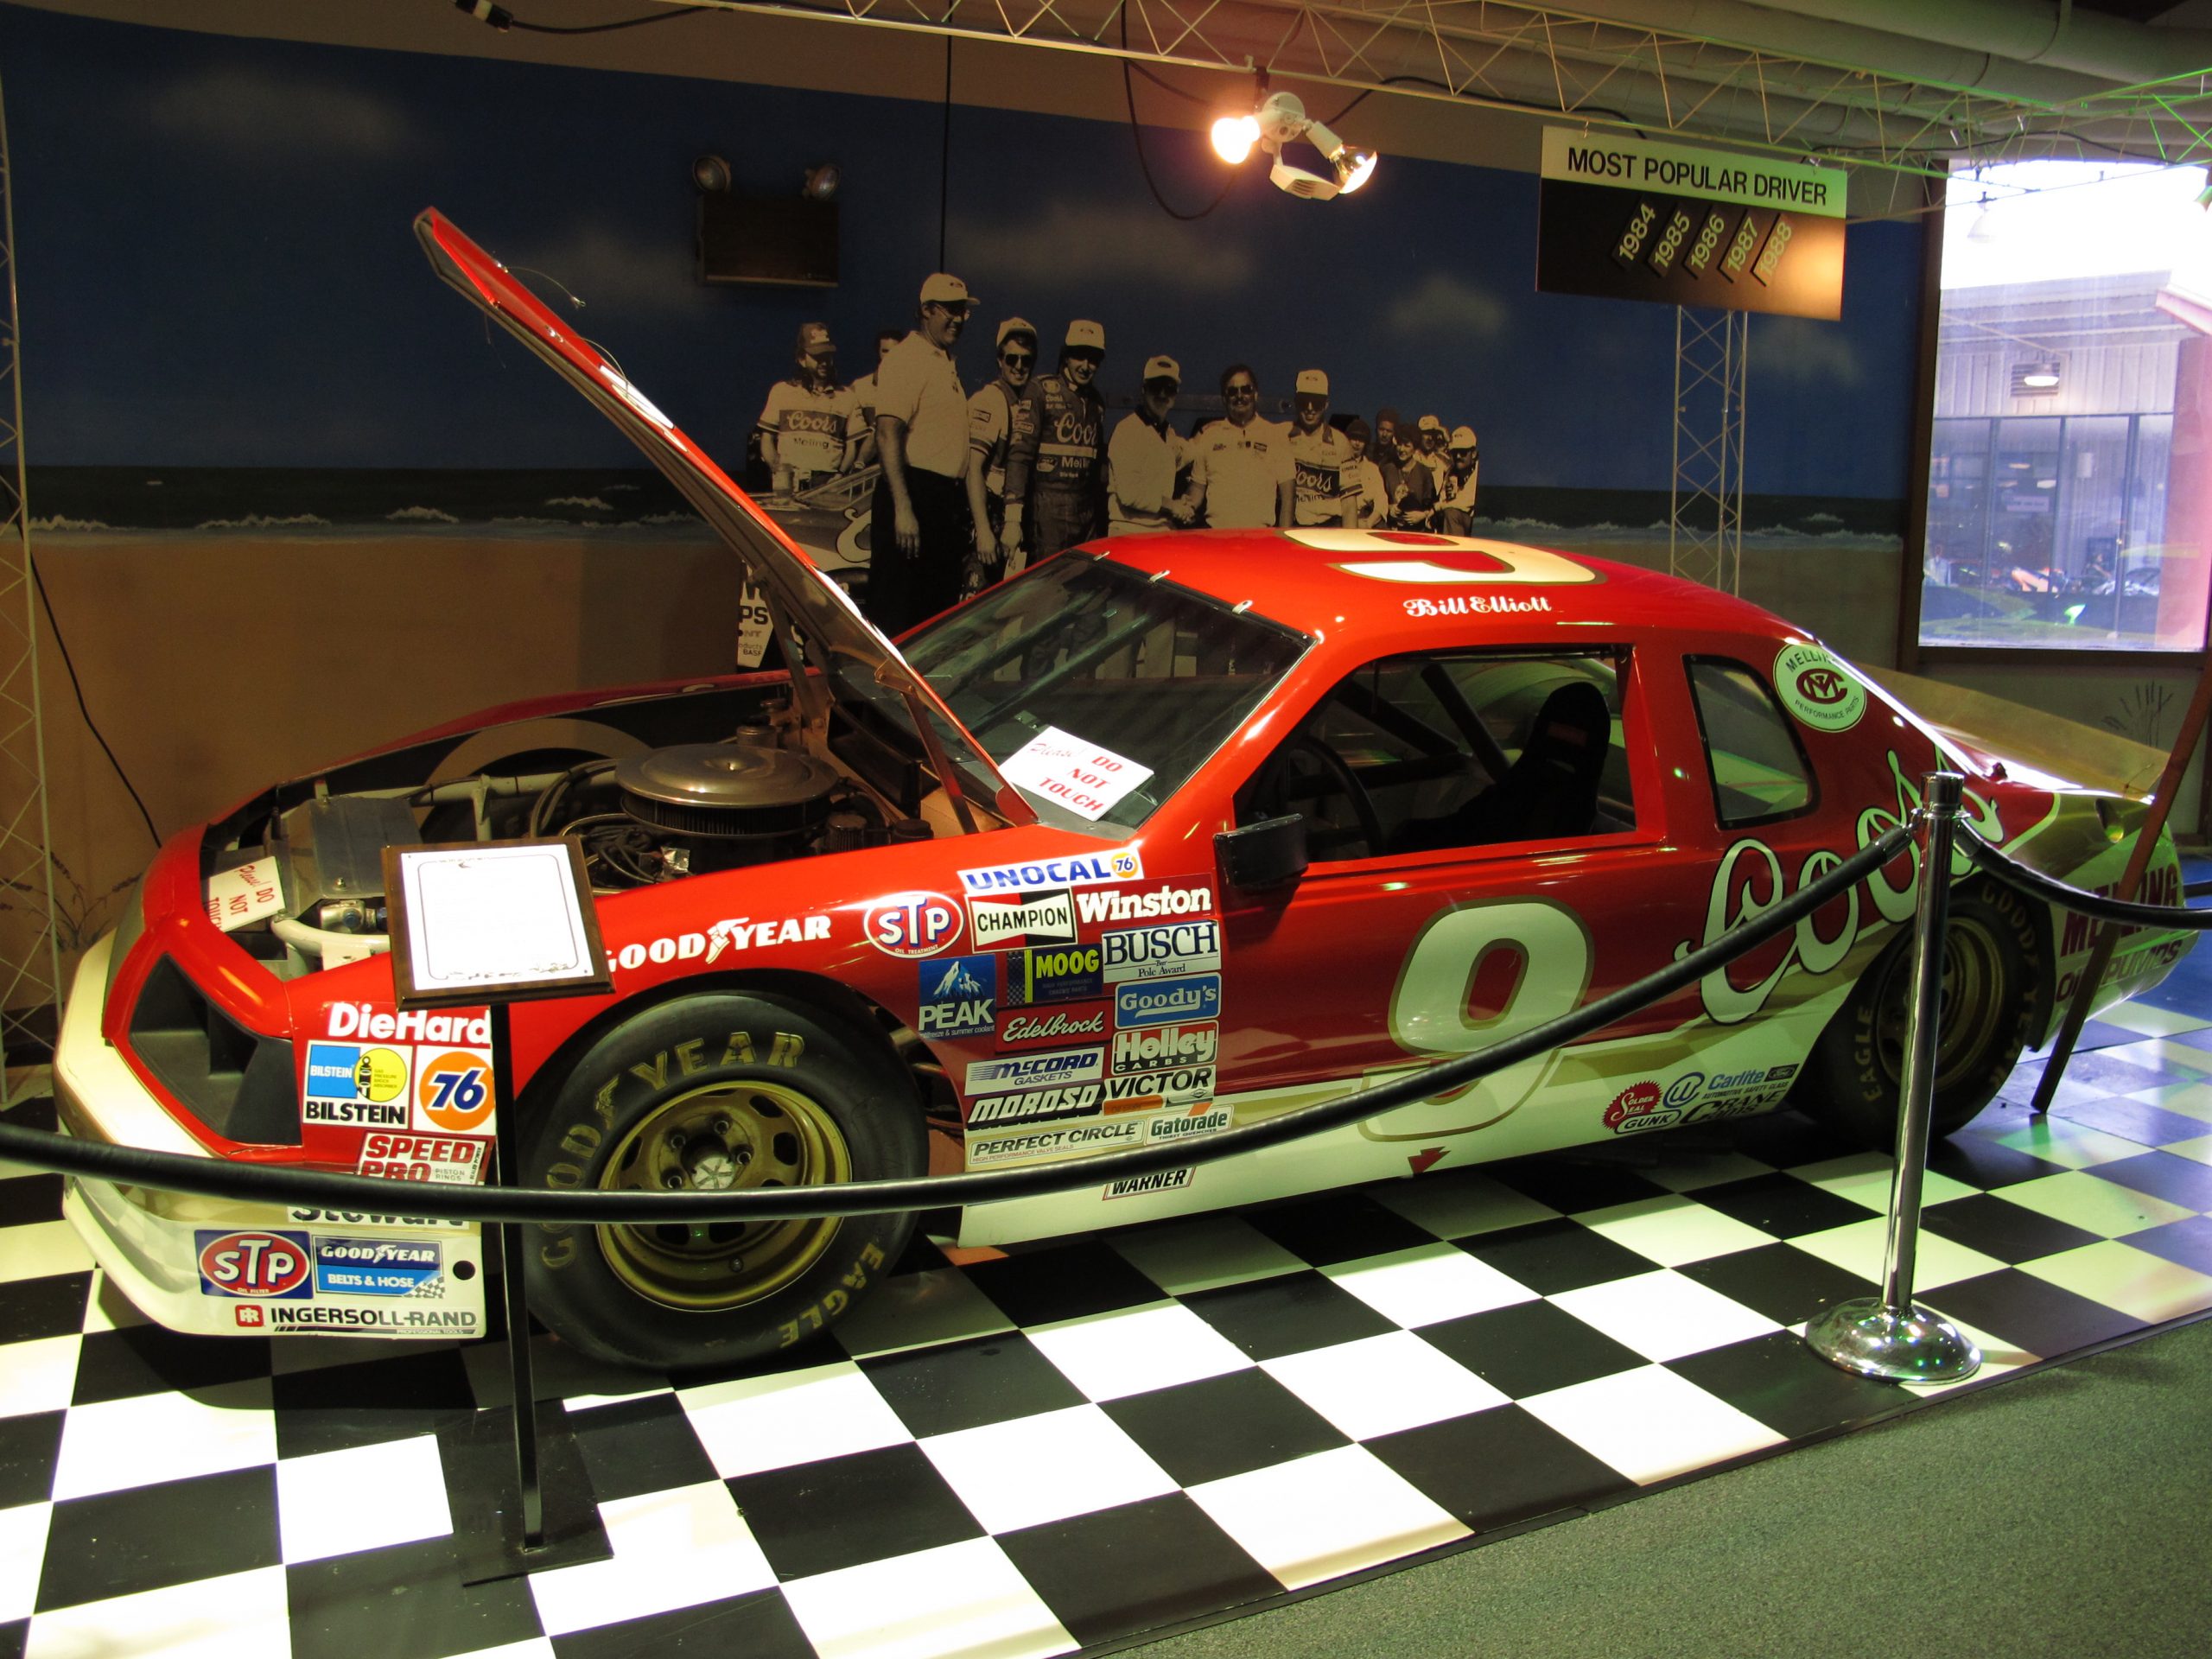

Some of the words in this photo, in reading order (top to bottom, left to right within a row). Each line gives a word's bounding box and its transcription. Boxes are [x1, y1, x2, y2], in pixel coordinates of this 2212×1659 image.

[1568, 146, 1637, 179] MOST
[1644, 157, 1747, 194] POPULAR
[1754, 174, 1827, 207] DRIVER
[1618, 203, 1656, 261] 1984
[1654, 213, 1691, 268] 1985
[1690, 213, 1725, 271] 1986
[1726, 216, 1759, 272] 1987
[1758, 220, 1793, 276] 1988
[786, 410, 837, 433] Coors
[1402, 597, 1468, 618] Bill
[1469, 595, 1553, 613] Elliott
[1795, 699, 1845, 720] PERFORMANCE
[1066, 767, 1111, 789] NOT
[1091, 756, 1122, 772] DO
[1039, 777, 1104, 811] TOUCH
[966, 858, 1111, 890] UNOCAL
[1116, 853, 1134, 873] 76
[229, 893, 249, 916] NOT
[256, 887, 275, 904] DO
[1077, 885, 1211, 925] Winston
[2061, 863, 2178, 957] MEING
[878, 895, 950, 946] STP
[977, 906, 1069, 932] CHAMPION
[907, 944, 938, 955] TREATMENT
[1103, 924, 1218, 966] BUSCH
[1036, 949, 1100, 979] MOOG
[1139, 968, 1156, 977] Pole
[1159, 963, 1186, 976] Award
[918, 998, 995, 1031] PEAK
[1120, 985, 1217, 1015] Goody's
[327, 1001, 491, 1044] DieHard
[951, 1027, 974, 1036] summer
[974, 1024, 995, 1033] coolant
[1002, 1010, 1104, 1043] Edelbrock
[1116, 1027, 1216, 1063] Holley
[1854, 1006, 1883, 1103] EAGLE
[310, 1065, 353, 1078] BILSTEIN
[1014, 1071, 1073, 1086] GASKETS
[1115, 1056, 1188, 1072] CARBS
[428, 1066, 488, 1115] 76
[1110, 1067, 1212, 1099] VICTOR
[1707, 1069, 1766, 1090] Carlite
[1744, 1084, 1767, 1094] SAFETY
[306, 1101, 406, 1125] BILSTEIN
[968, 1084, 1102, 1124] MOROSO
[1151, 1111, 1228, 1137] Gatorade
[1624, 1113, 1671, 1129] GUNK
[365, 1135, 476, 1164] SPEED
[540, 1031, 806, 1270] GODYEAR
[974, 1132, 1066, 1157] PERFECT
[1068, 1122, 1137, 1143] CIRCLE
[989, 1150, 1035, 1161] PERFORMANCE
[360, 1160, 432, 1183] PRO
[435, 1167, 466, 1176] PISTON
[1112, 1169, 1186, 1195] WARNER
[213, 1238, 296, 1286] STP
[321, 1244, 436, 1263] GOODYEAR
[327, 1273, 363, 1286] BELTS
[364, 1274, 375, 1287] &
[378, 1275, 415, 1287] HOSE
[778, 1242, 886, 1349] EAGLE
[270, 1306, 477, 1326] INGERSOLL-RAND
